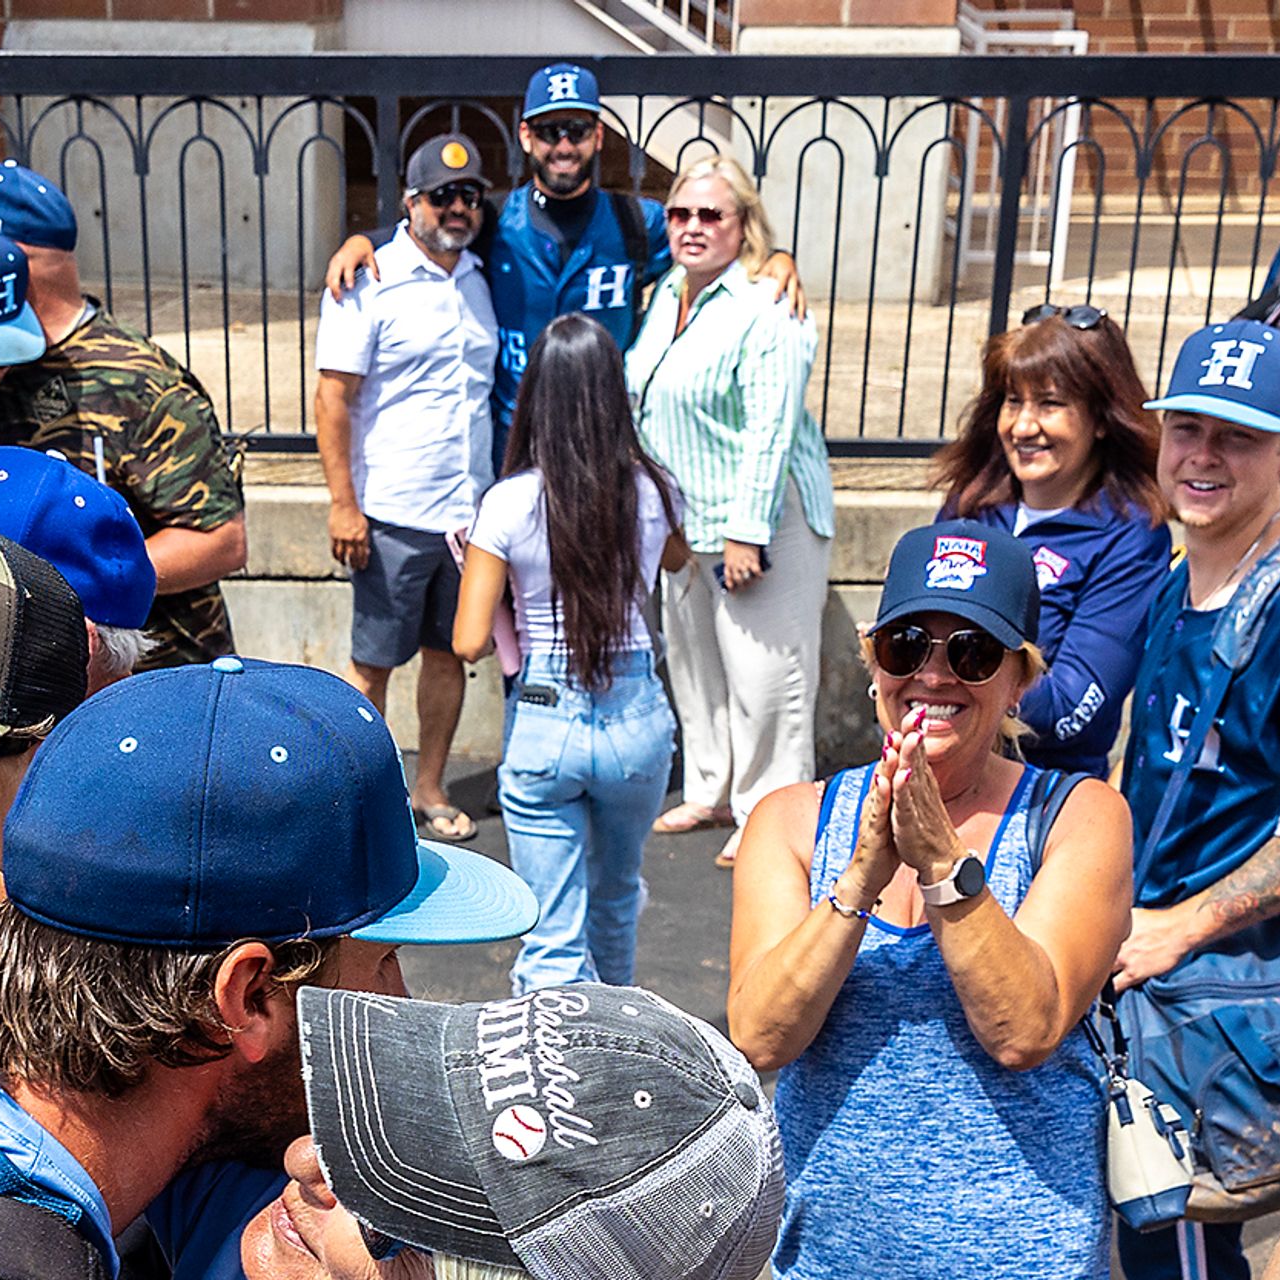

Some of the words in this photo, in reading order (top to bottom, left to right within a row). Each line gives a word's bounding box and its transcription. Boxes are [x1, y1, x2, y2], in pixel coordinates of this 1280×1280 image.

[546, 73, 580, 100] H
[582, 263, 631, 311] H
[1198, 339, 1266, 390] H
[532, 990, 600, 1150] Baseball
